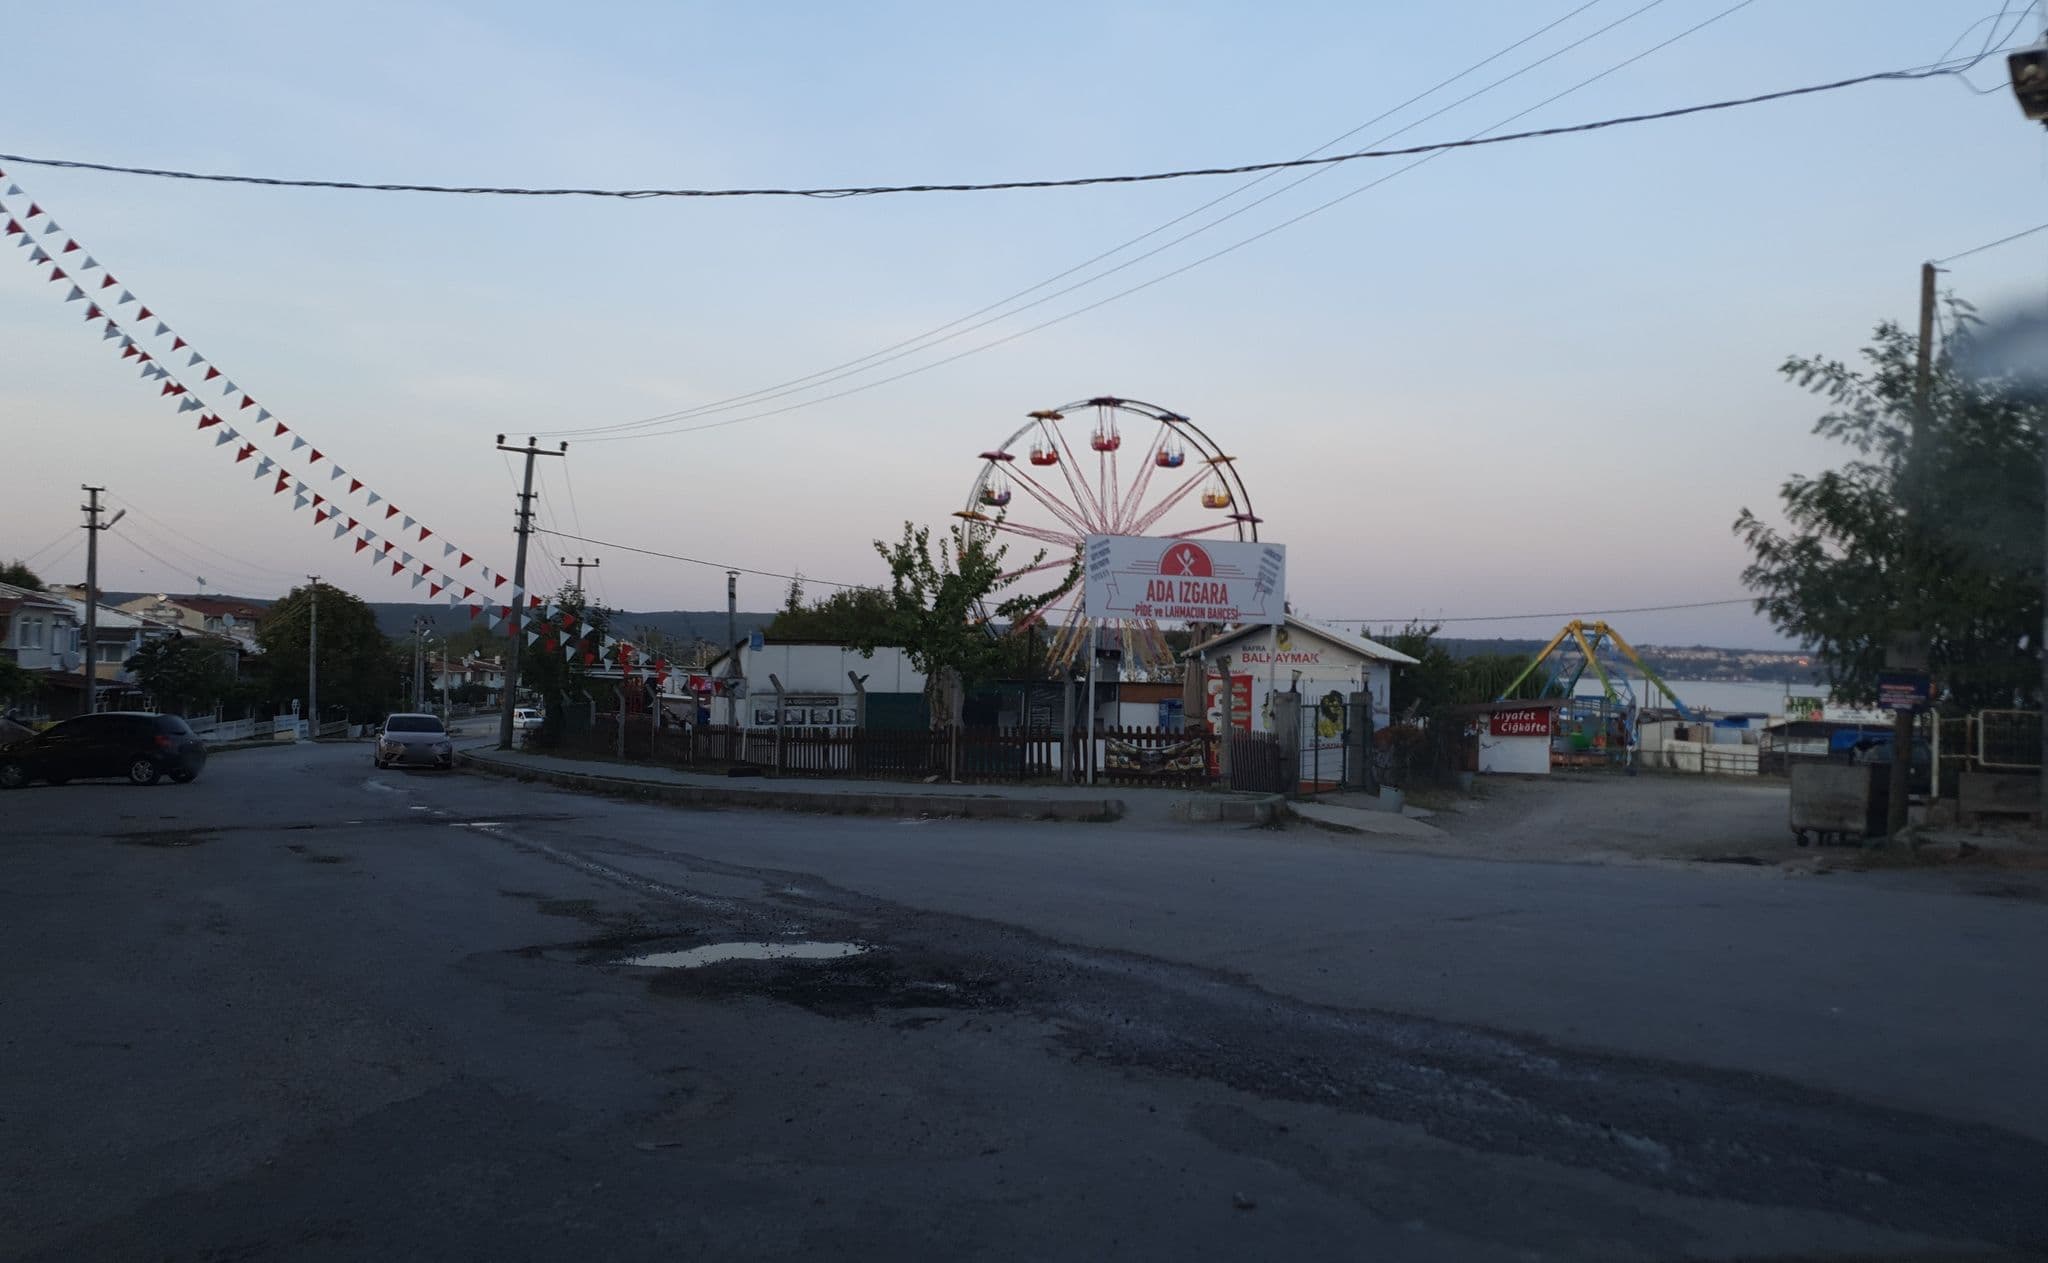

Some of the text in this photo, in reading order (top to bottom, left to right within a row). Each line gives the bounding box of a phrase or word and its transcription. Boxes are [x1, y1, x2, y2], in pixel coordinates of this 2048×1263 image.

[1146, 579, 1229, 605] ADA IZGARA
[1135, 601, 1152, 617] PİDE
[1154, 608, 1163, 617] ve
[1165, 605, 1205, 619] LAHMACUN
